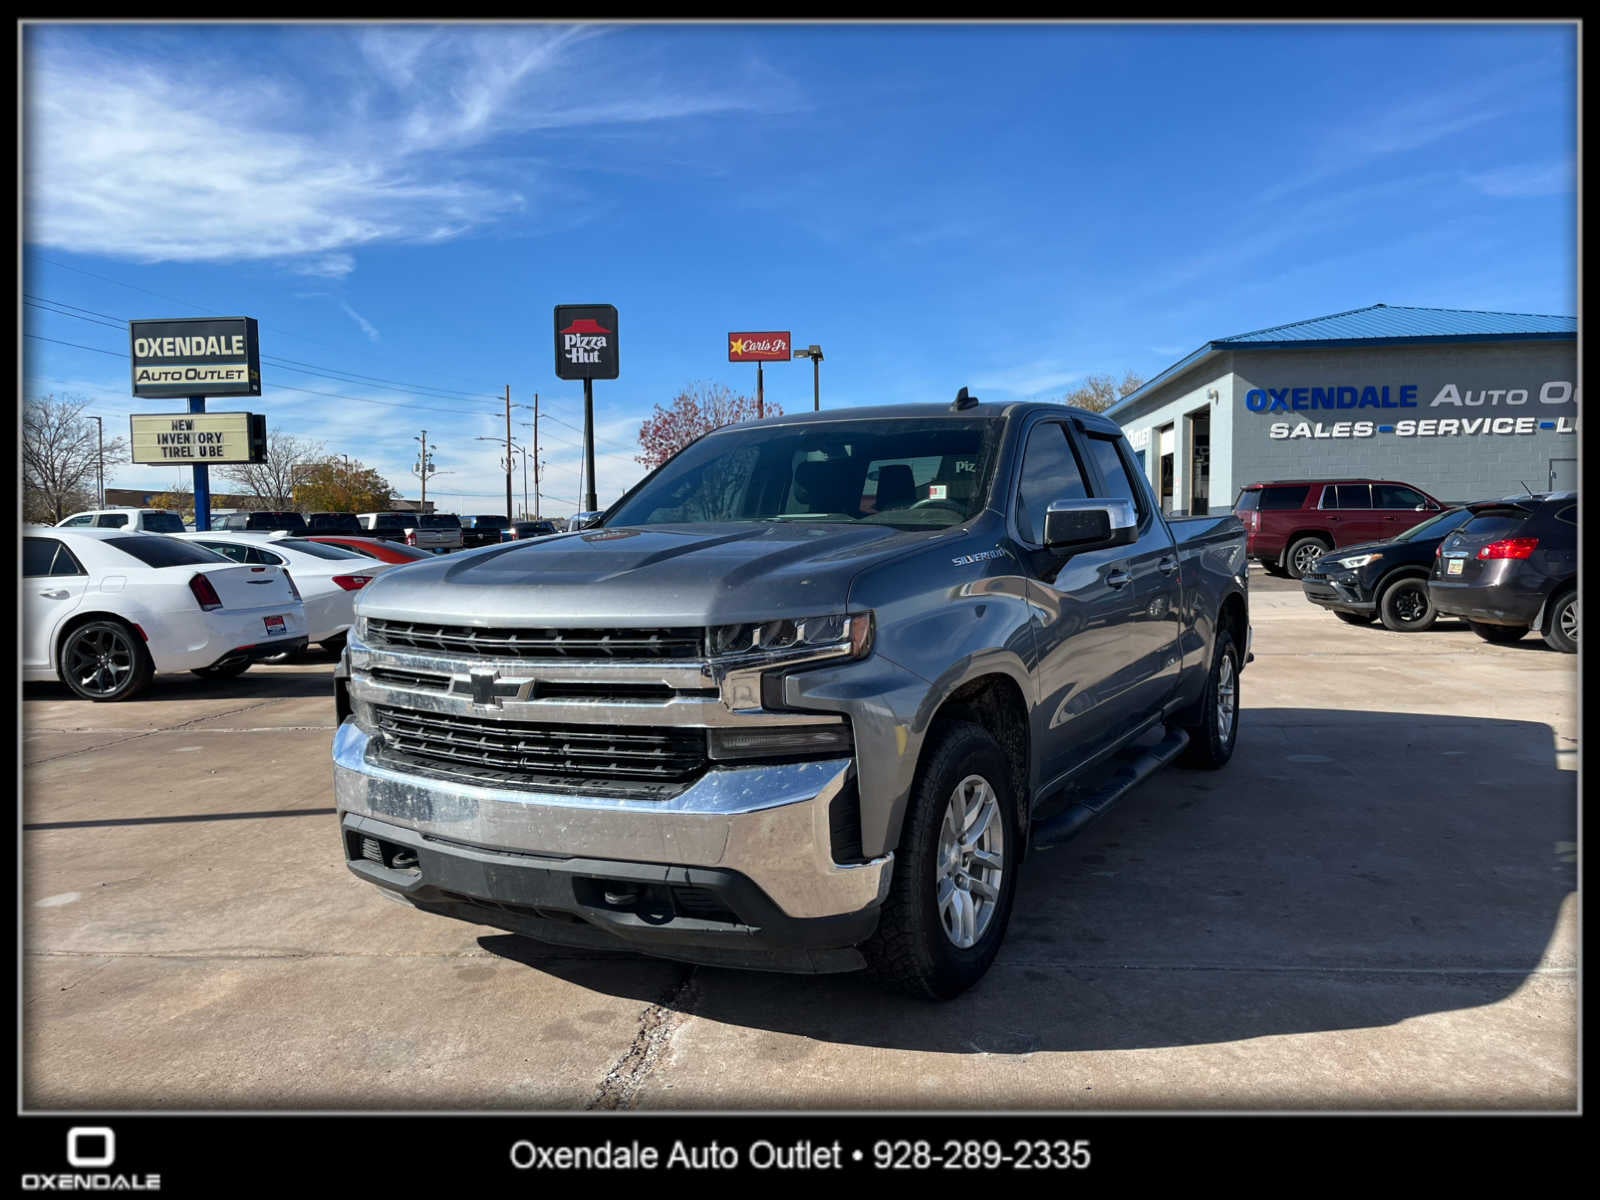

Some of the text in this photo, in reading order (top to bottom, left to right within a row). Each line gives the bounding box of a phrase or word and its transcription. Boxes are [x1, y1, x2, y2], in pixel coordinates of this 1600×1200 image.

[134, 335, 245, 358] OXENDALE
[564, 333, 607, 350] Pizza
[566, 347, 600, 364] Hut
[137, 368, 244, 382] AUTO OUTLET
[1245, 385, 1418, 412] OXENDALE
[1430, 383, 1528, 408] AUTO
[171, 419, 193, 431] NEW
